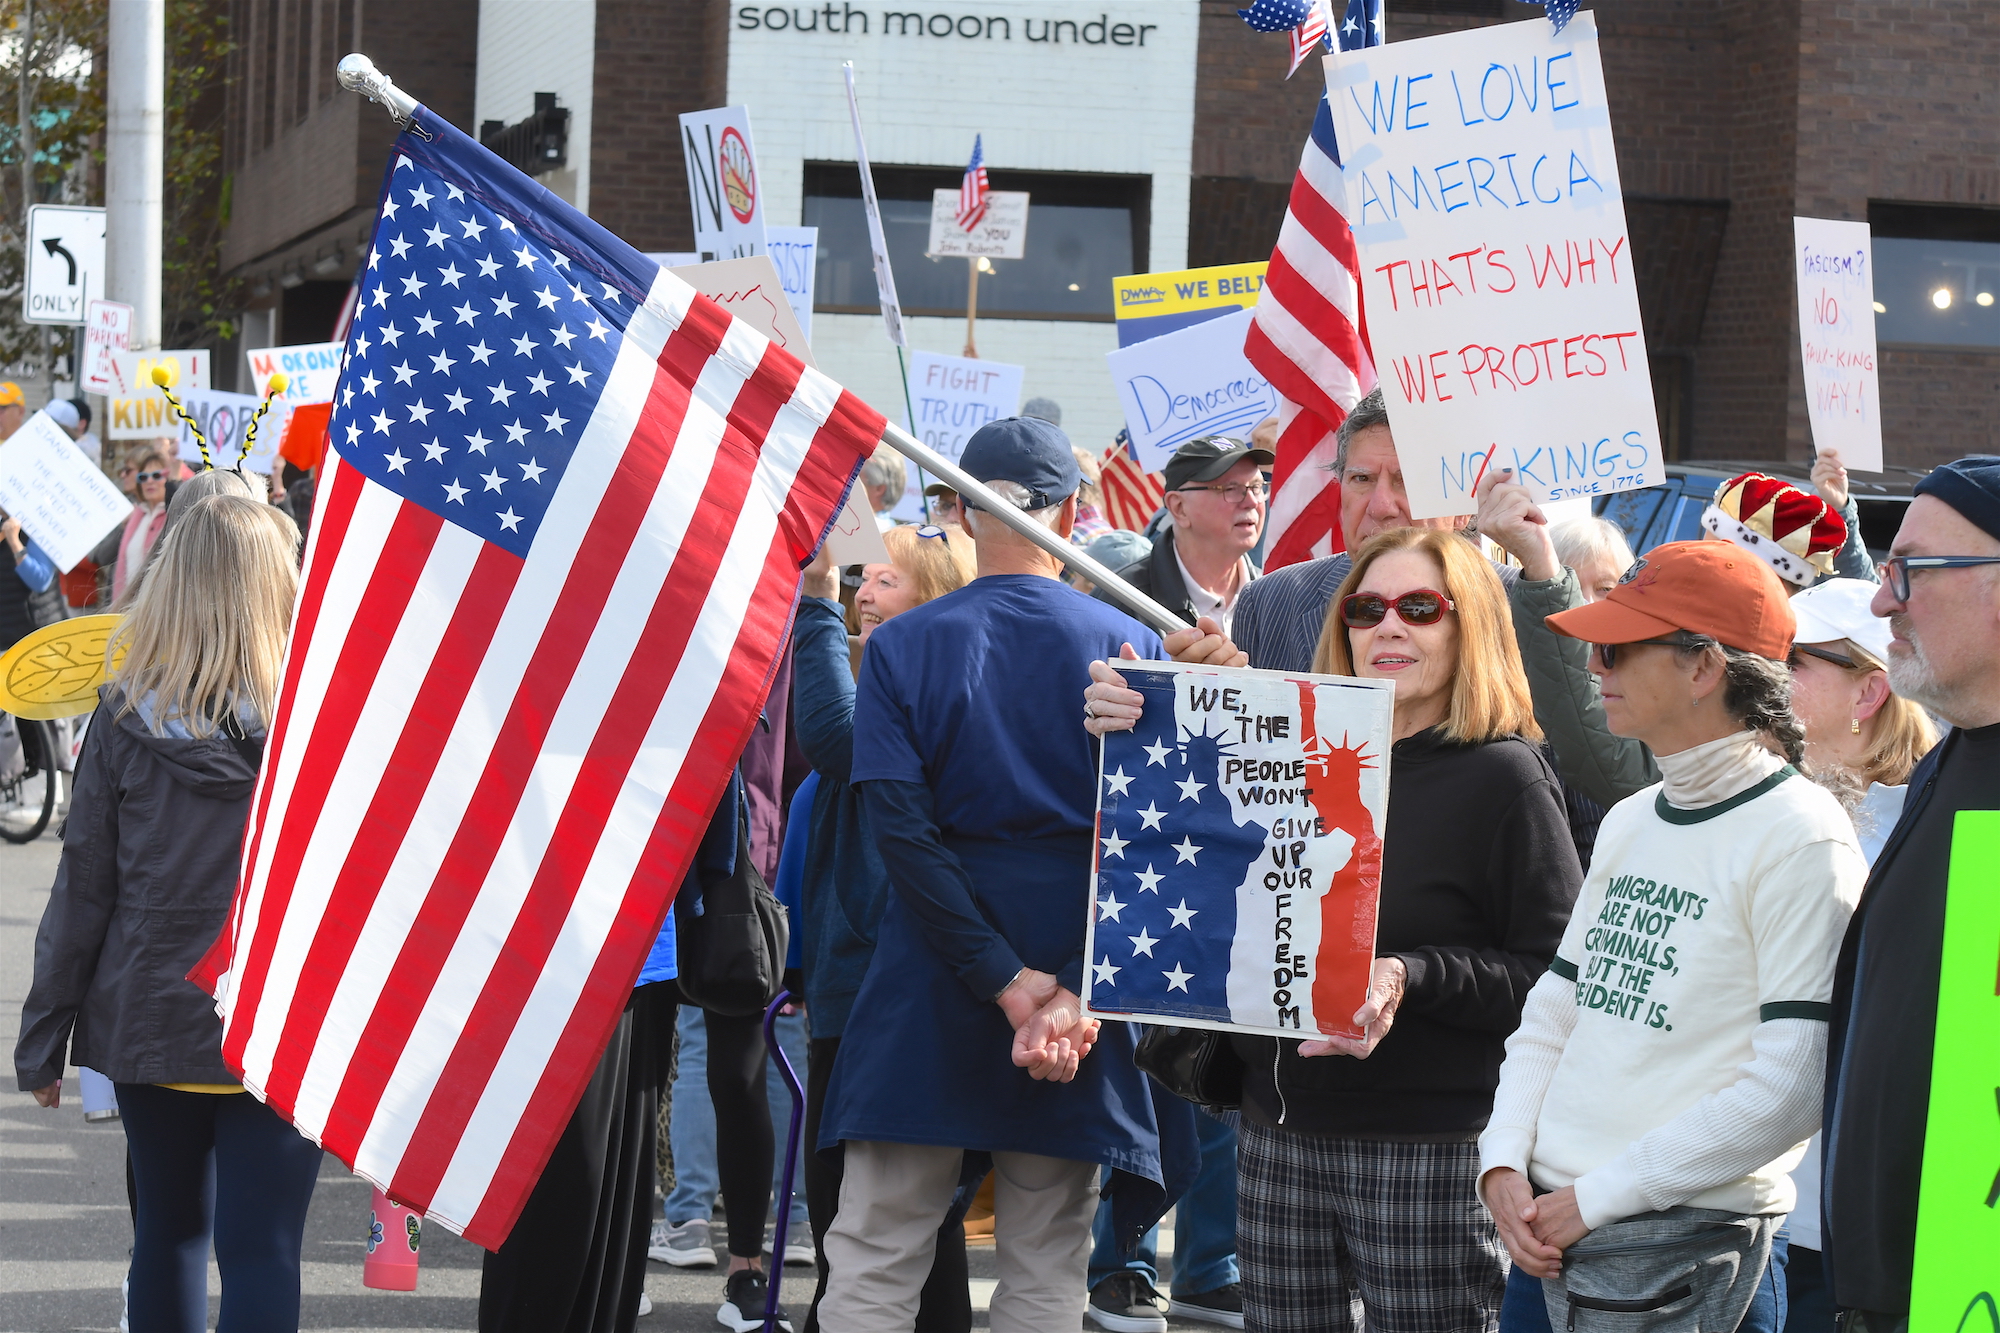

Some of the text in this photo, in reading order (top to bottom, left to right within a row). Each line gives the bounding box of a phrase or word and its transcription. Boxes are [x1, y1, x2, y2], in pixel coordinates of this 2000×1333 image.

[738, 3, 1158, 47] south moon under
[1350, 51, 1579, 135] WE LOVE
[1361, 150, 1603, 226] AMERICA
[984, 227, 1011, 241] YOU
[767, 242, 813, 293] SIST
[1375, 236, 1624, 311] THAT'S WHY
[1804, 245, 1865, 275] FASCISM?
[1175, 281, 1209, 300] WE
[1218, 274, 1265, 296] BELI
[32, 294, 79, 313] ONLY
[1814, 287, 1839, 325] NO
[102, 311, 118, 328] NO
[90, 328, 128, 349] PARKING
[99, 350, 109, 359] AN
[1392, 331, 1638, 403] WE PROTEST
[927, 364, 1000, 394] FIGHT
[114, 397, 181, 429] KING
[921, 398, 998, 427] TRUTH
[1127, 375, 1277, 435] Democracy
[924, 430, 963, 457] DEC
[1513, 431, 1648, 486] KINGS
[36, 422, 117, 512] STAND UNITED
[34, 459, 90, 519] THE PEOPLE
[1549, 473, 1645, 500] SINCE 1776
[8, 475, 68, 539] WILL NEVER
[1190, 686, 1248, 714] WE,
[1234, 715, 1290, 744] THE
[1225, 759, 1306, 785] PEOPLE
[1238, 787, 1314, 808] WON'T
[1271, 817, 1327, 839] GIVE
[1272, 840, 1307, 870] UP
[1263, 868, 1313, 892] OUR
[1605, 874, 1709, 921] MIGRANTS
[1598, 901, 1676, 940] ARE NOT
[1585, 955, 1655, 995] BUT THE
[1644, 1001, 1673, 1032] IS.
